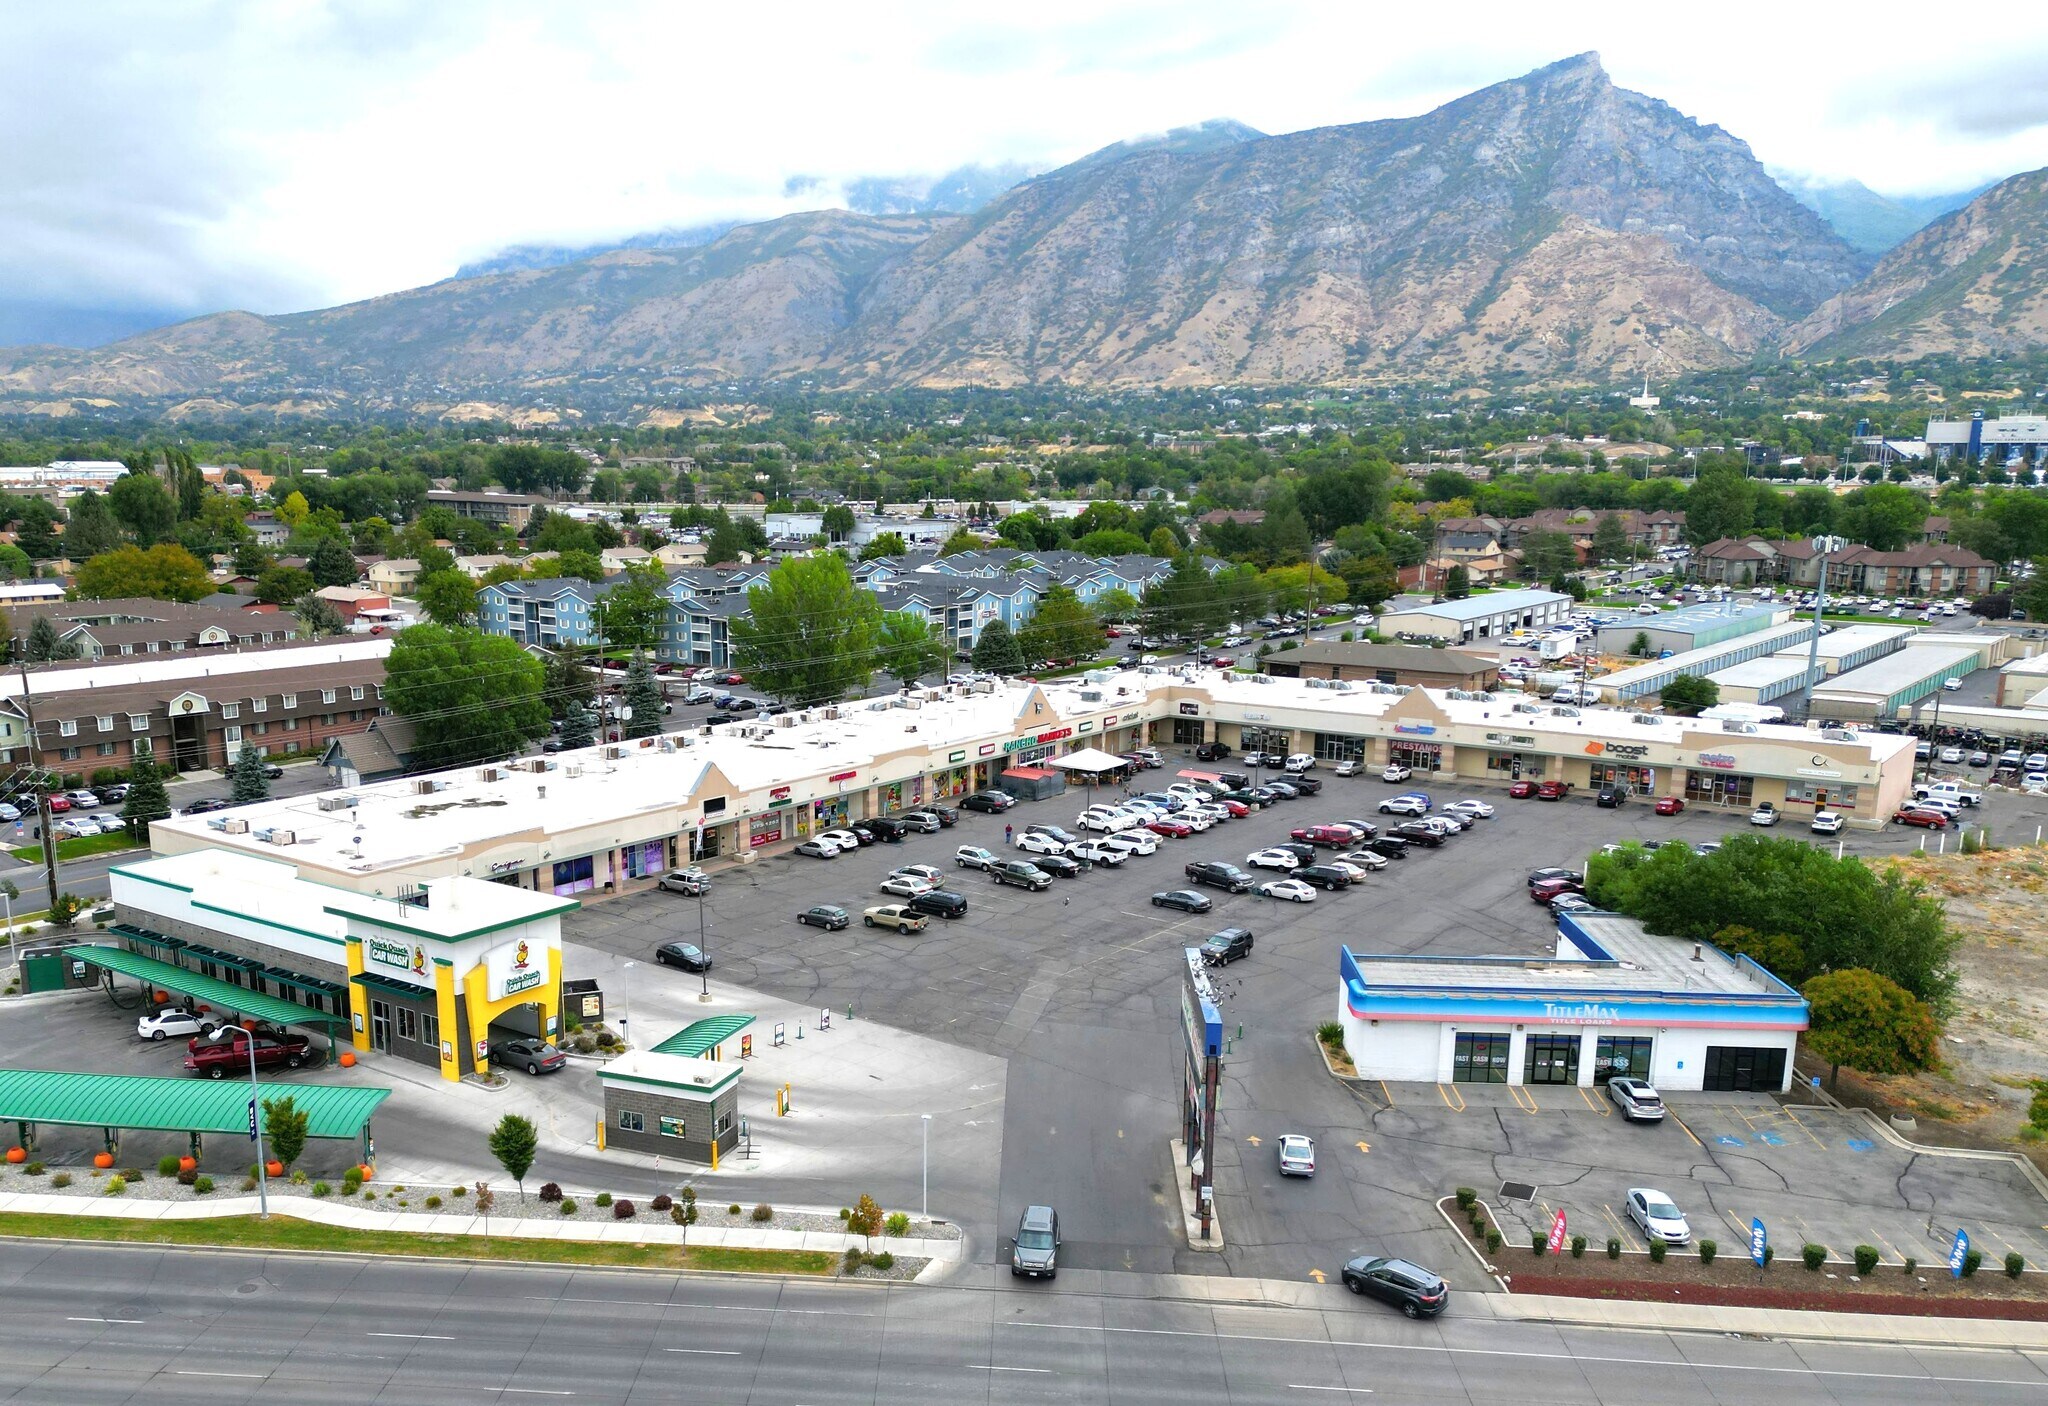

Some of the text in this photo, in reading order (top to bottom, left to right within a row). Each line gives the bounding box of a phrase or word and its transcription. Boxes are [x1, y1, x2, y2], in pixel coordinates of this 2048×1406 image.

[1004, 727, 1072, 752] RANCHO MARKETS
[1606, 742, 1649, 756] boost
[370, 939, 408, 954] Quick Quack
[373, 949, 408, 967] CAR WASH
[509, 976, 539, 992] CAR WASH
